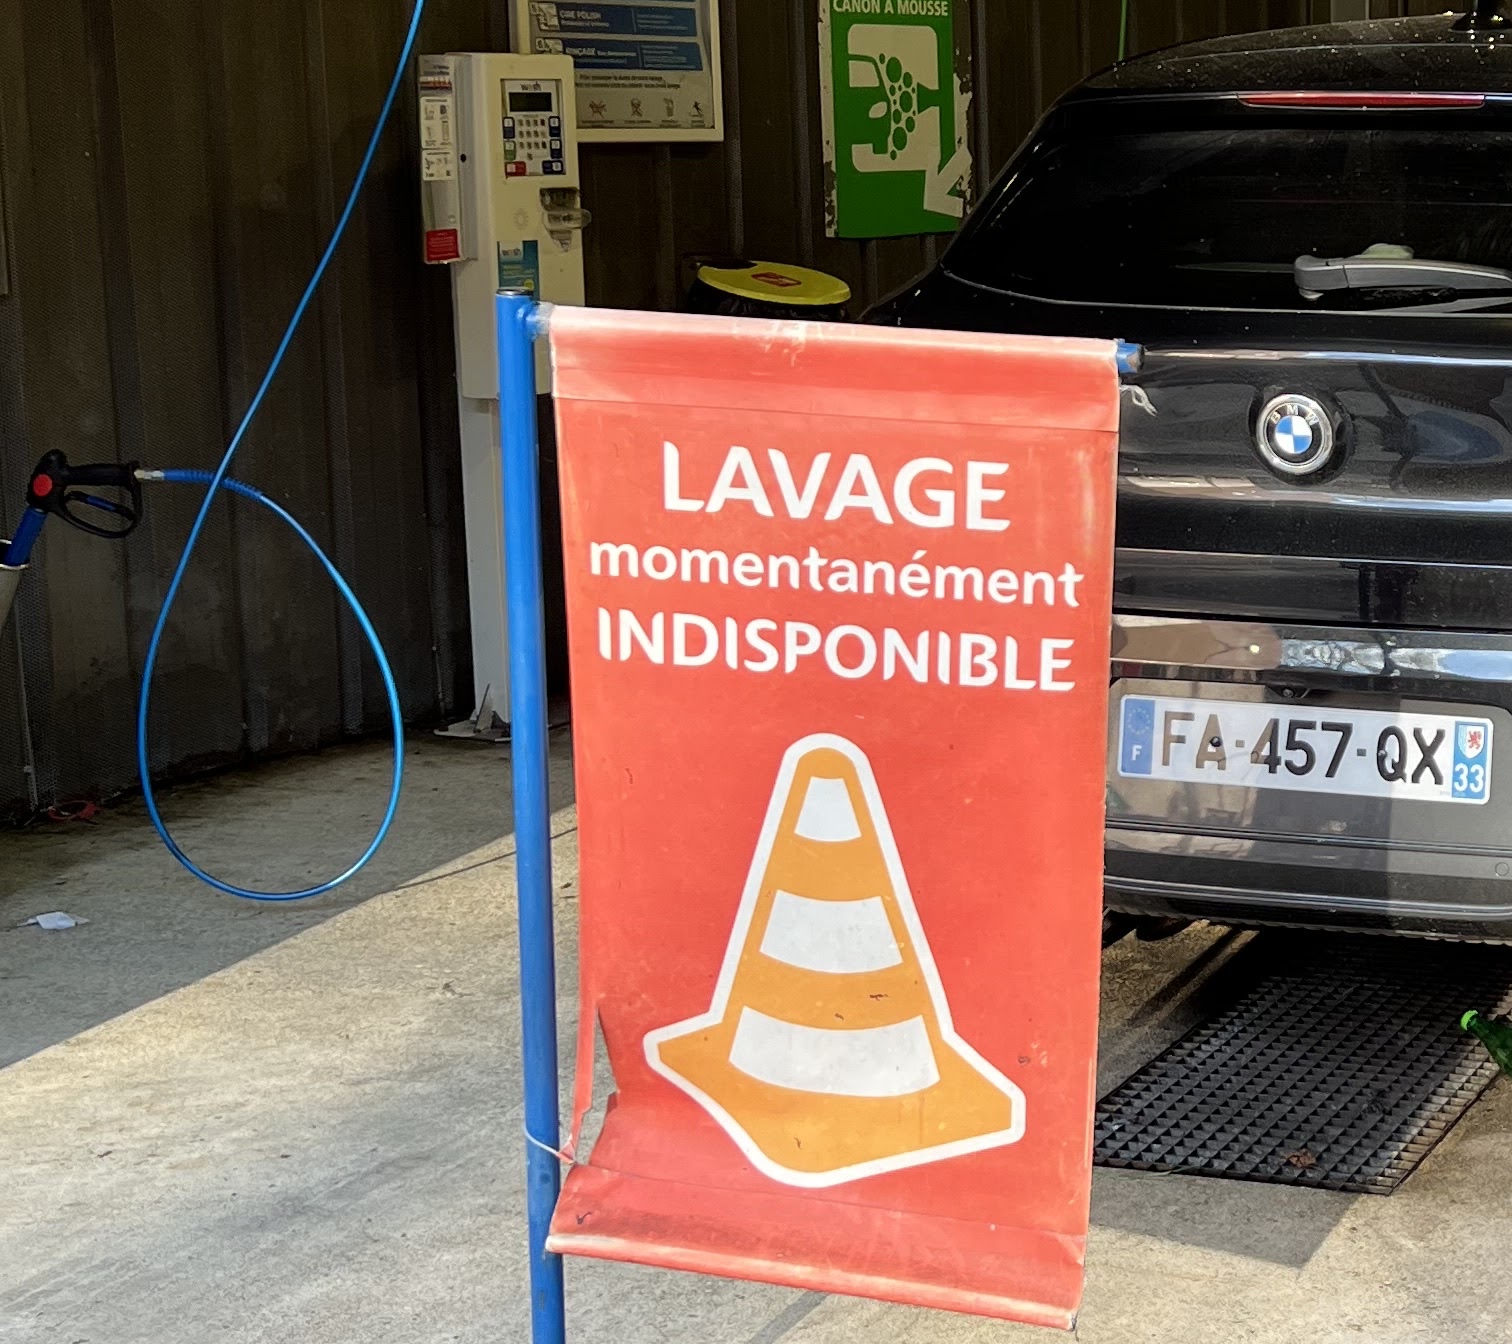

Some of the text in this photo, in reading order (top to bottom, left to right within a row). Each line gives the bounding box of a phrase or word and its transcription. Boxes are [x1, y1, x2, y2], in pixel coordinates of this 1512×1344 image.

[897, 0, 949, 17] MOUSSE
[1269, 403, 1320, 425] BMW
[663, 440, 1011, 532] LAVAGE
[589, 540, 1085, 608] momentanément
[596, 606, 1076, 692] INDISPONIBLE
[1131, 744, 1142, 762] F
[1161, 710, 1447, 786] FA-457-QX
[1453, 762, 1485, 794] 33
